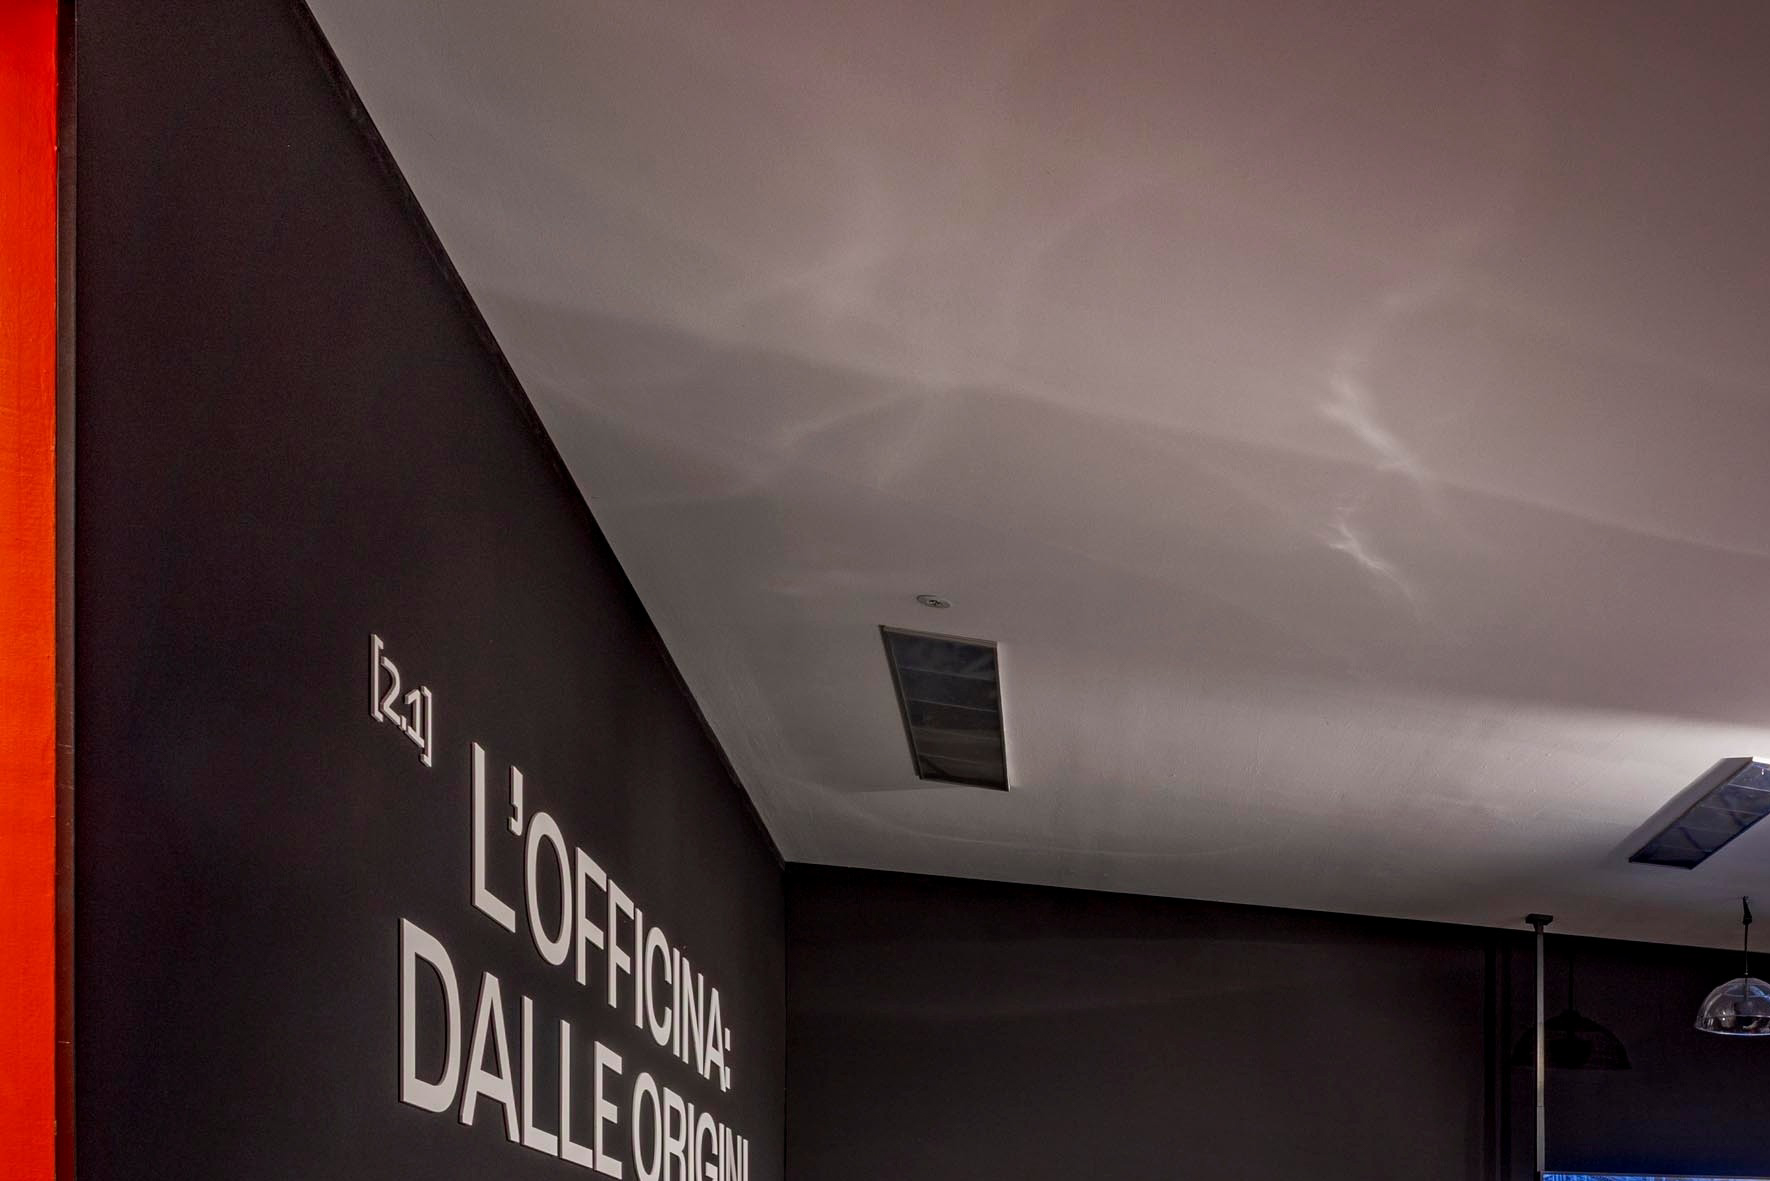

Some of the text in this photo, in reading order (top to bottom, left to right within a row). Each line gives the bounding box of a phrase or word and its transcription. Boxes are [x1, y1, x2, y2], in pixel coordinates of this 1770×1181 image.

[371, 634, 432, 767] [2.1]
[470, 741, 732, 1092] L'OFFICINA:
[400, 917, 623, 1180] DALLE
